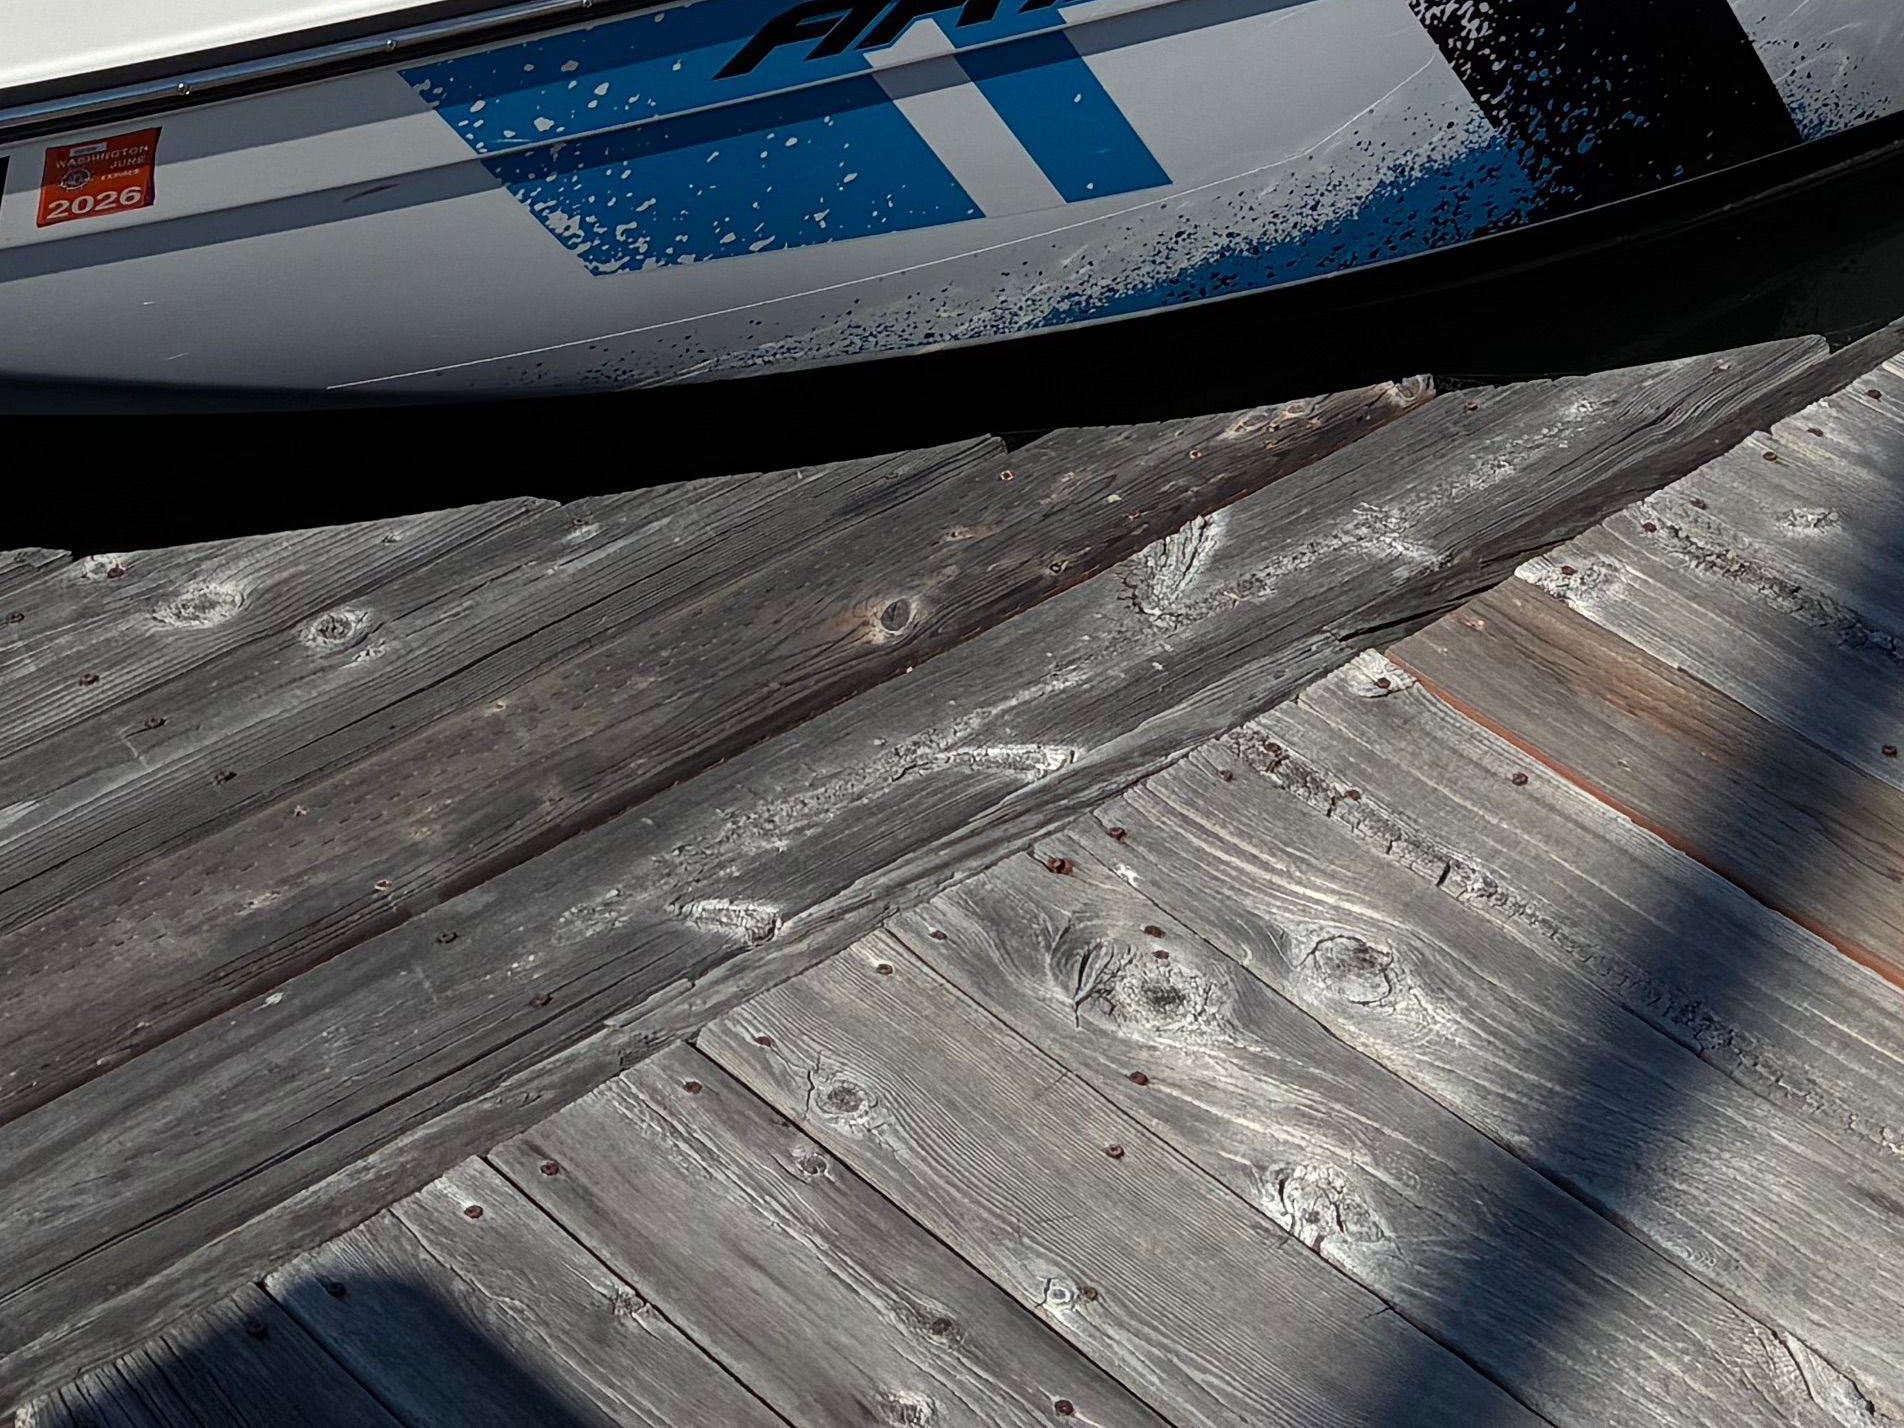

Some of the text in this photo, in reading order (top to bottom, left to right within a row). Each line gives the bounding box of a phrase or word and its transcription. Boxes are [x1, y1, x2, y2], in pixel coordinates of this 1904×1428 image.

[55, 144, 149, 169] WASHINGTON
[109, 154, 147, 169] JUNE
[46, 186, 143, 220] 2026
